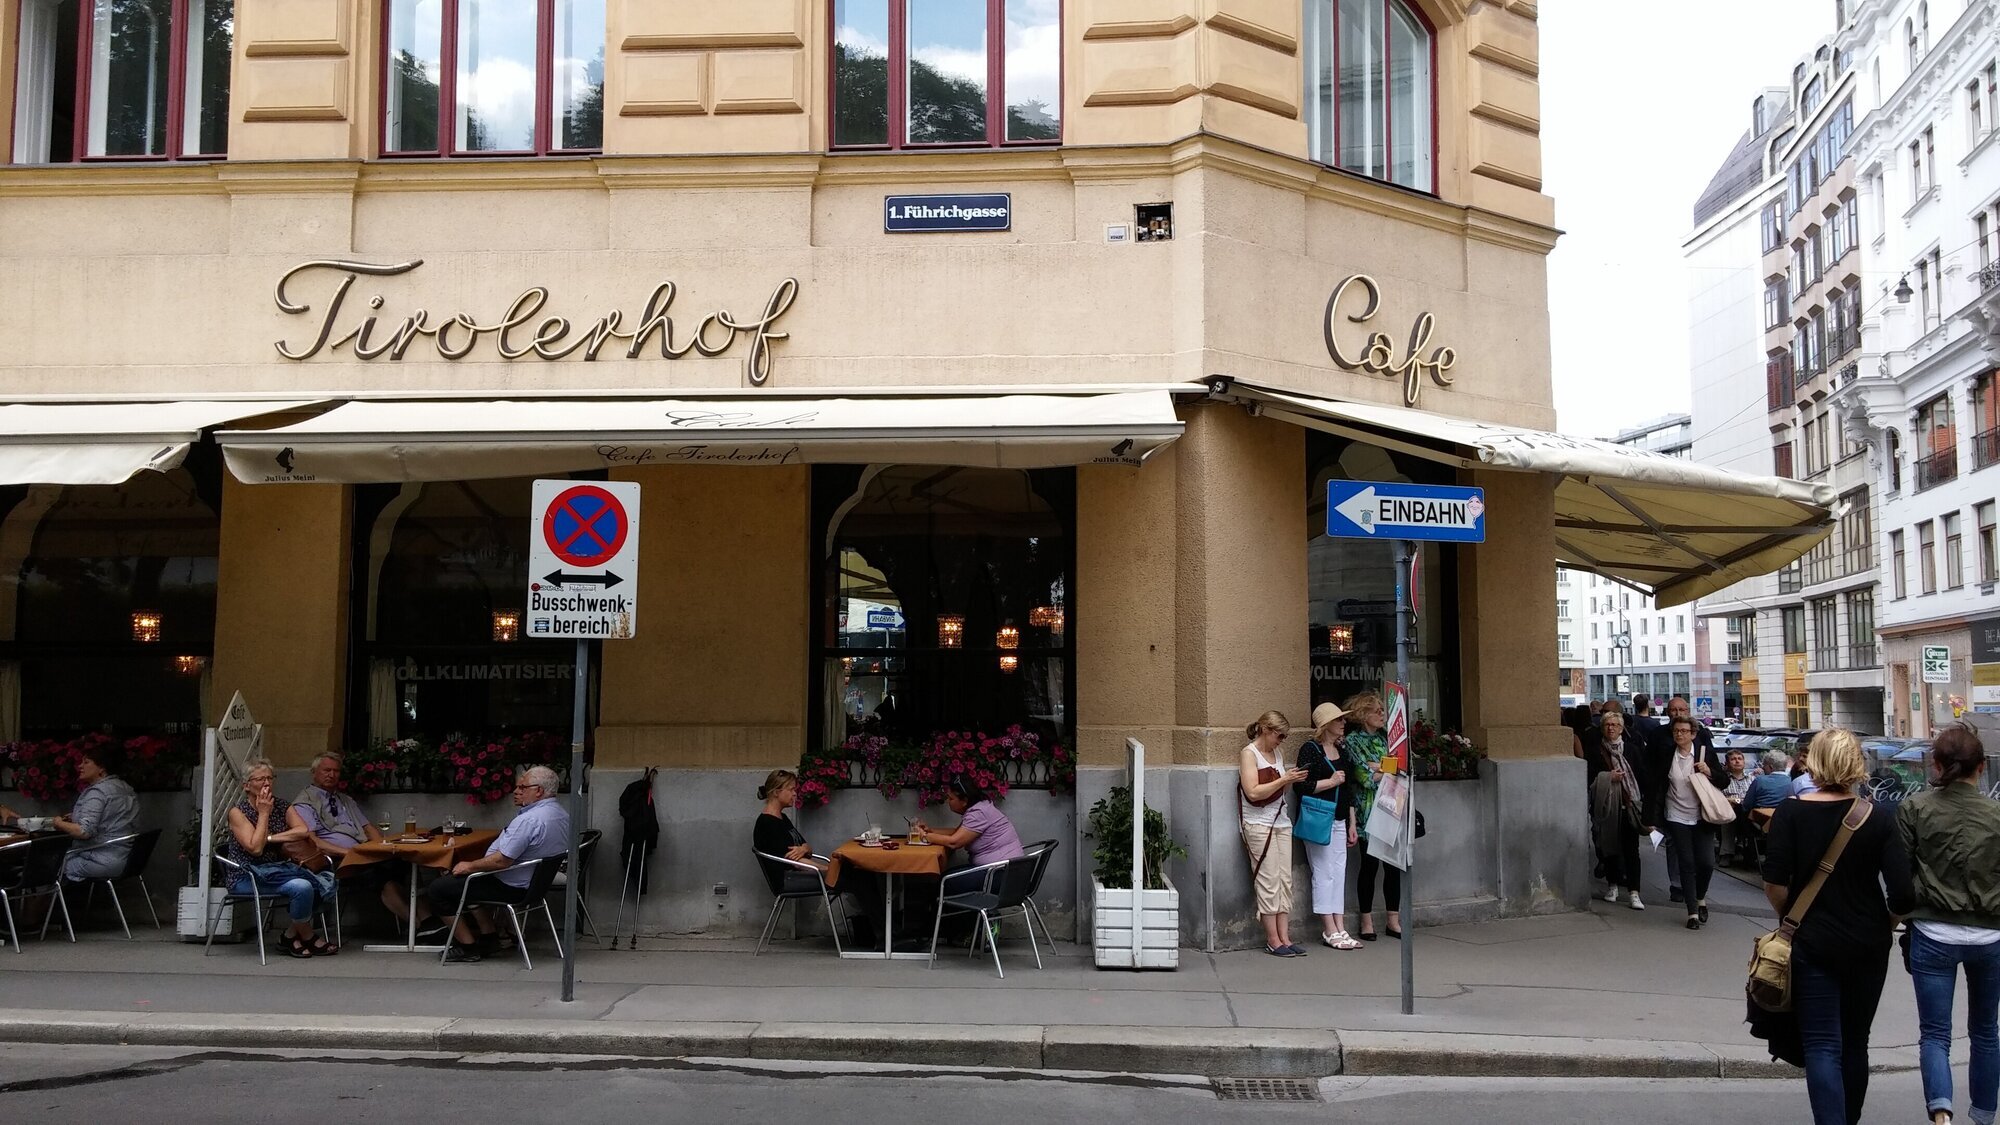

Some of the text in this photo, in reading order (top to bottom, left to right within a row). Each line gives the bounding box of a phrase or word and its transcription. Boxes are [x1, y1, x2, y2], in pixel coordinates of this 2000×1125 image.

[904, 205, 1007, 221] Führichgasse
[273, 259, 799, 386] Tirolerhof
[1324, 274, 1456, 408] Cafe
[666, 445, 799, 464] Tirolerhof
[1380, 499, 1466, 525] EINBAHN
[532, 592, 632, 613] Busschwenk-
[553, 615, 609, 635] bereich
